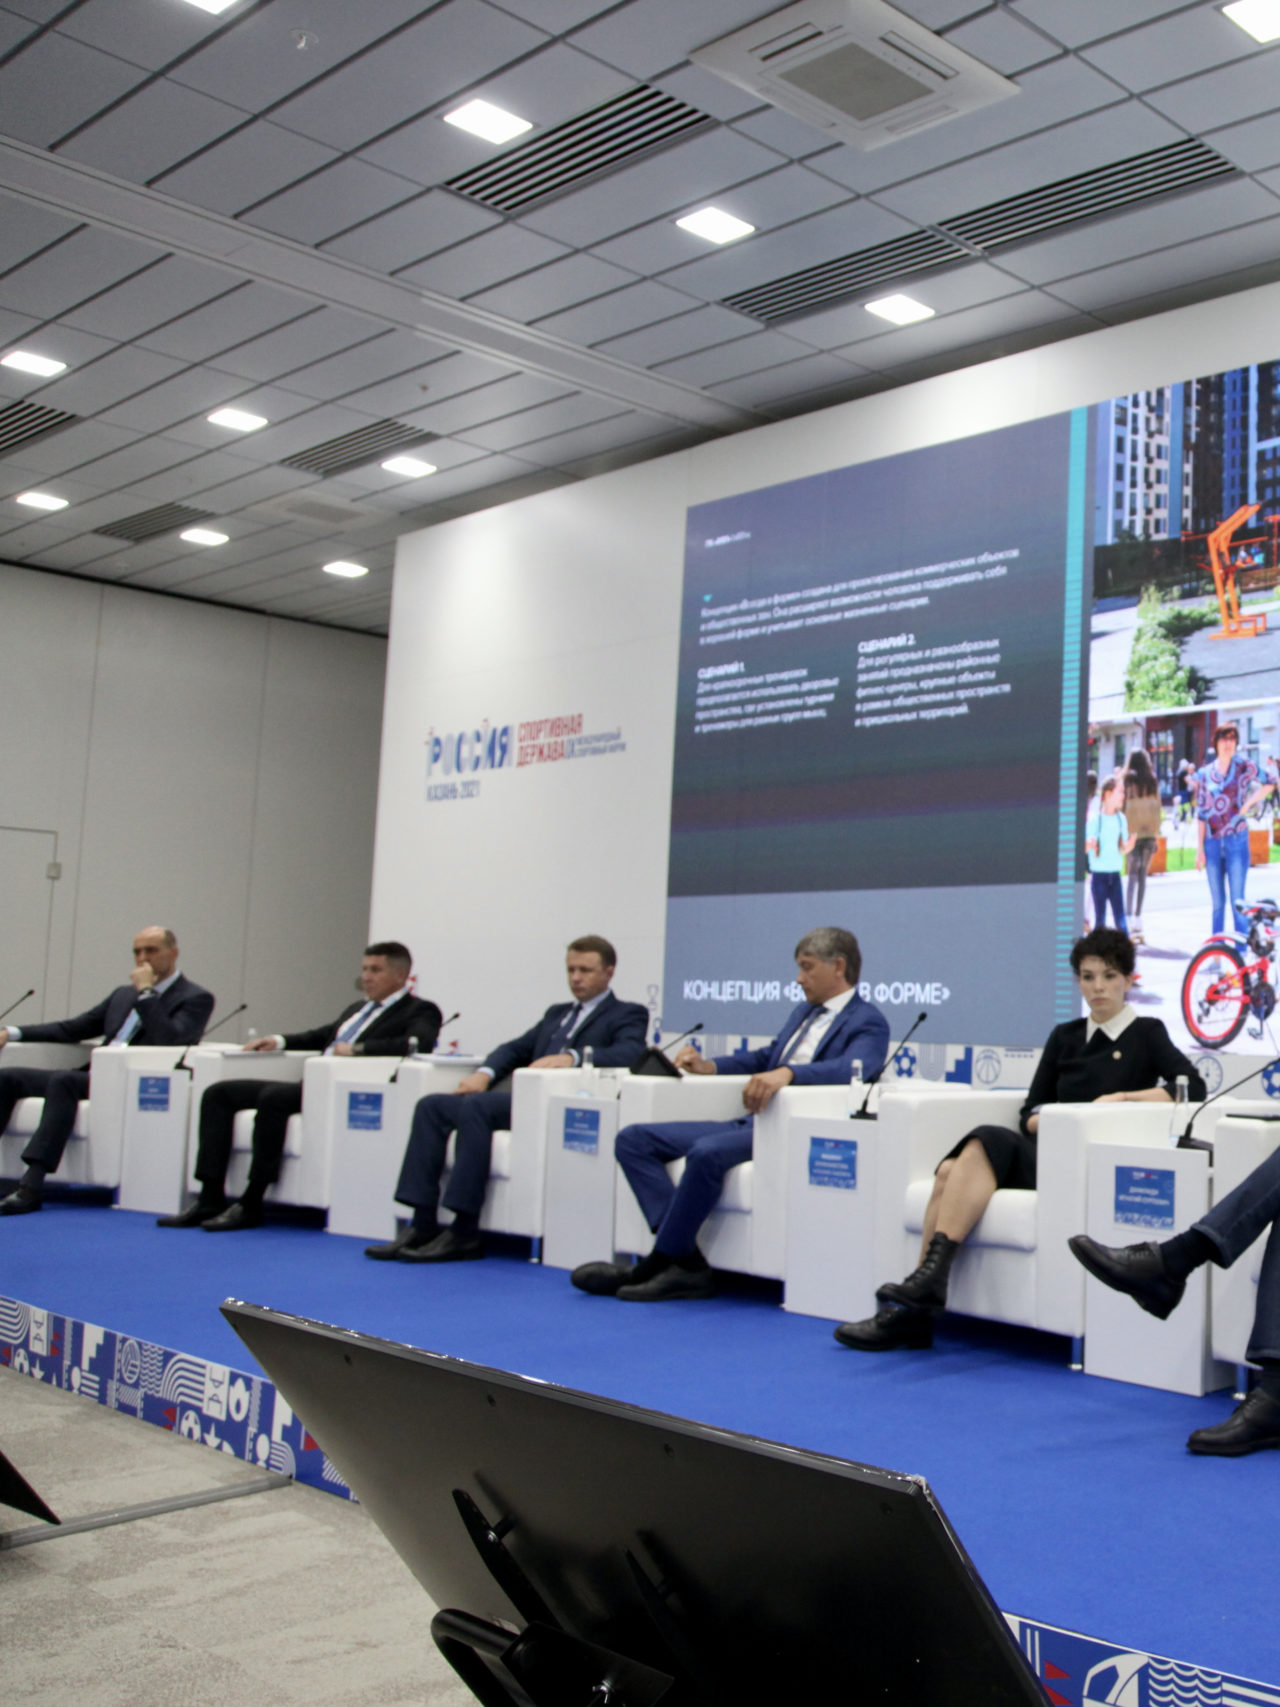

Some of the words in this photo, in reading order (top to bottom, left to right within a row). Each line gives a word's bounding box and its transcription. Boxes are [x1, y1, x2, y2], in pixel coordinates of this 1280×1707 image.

[858, 633, 906, 653] СЦЕНАРИЙ
[697, 661, 739, 679] СЦЕНАРИЙ
[518, 713, 583, 743] СПОРТИВНАЯ
[427, 724, 514, 777] РОССИЯ
[516, 740, 565, 767] ДЕРЖАВА
[460, 779, 480, 800] 2021
[683, 980, 780, 1004] КОНЦЕПЦИЯ
[859, 981, 871, 1002] В
[874, 981, 950, 1005] ФОРМЕ»
